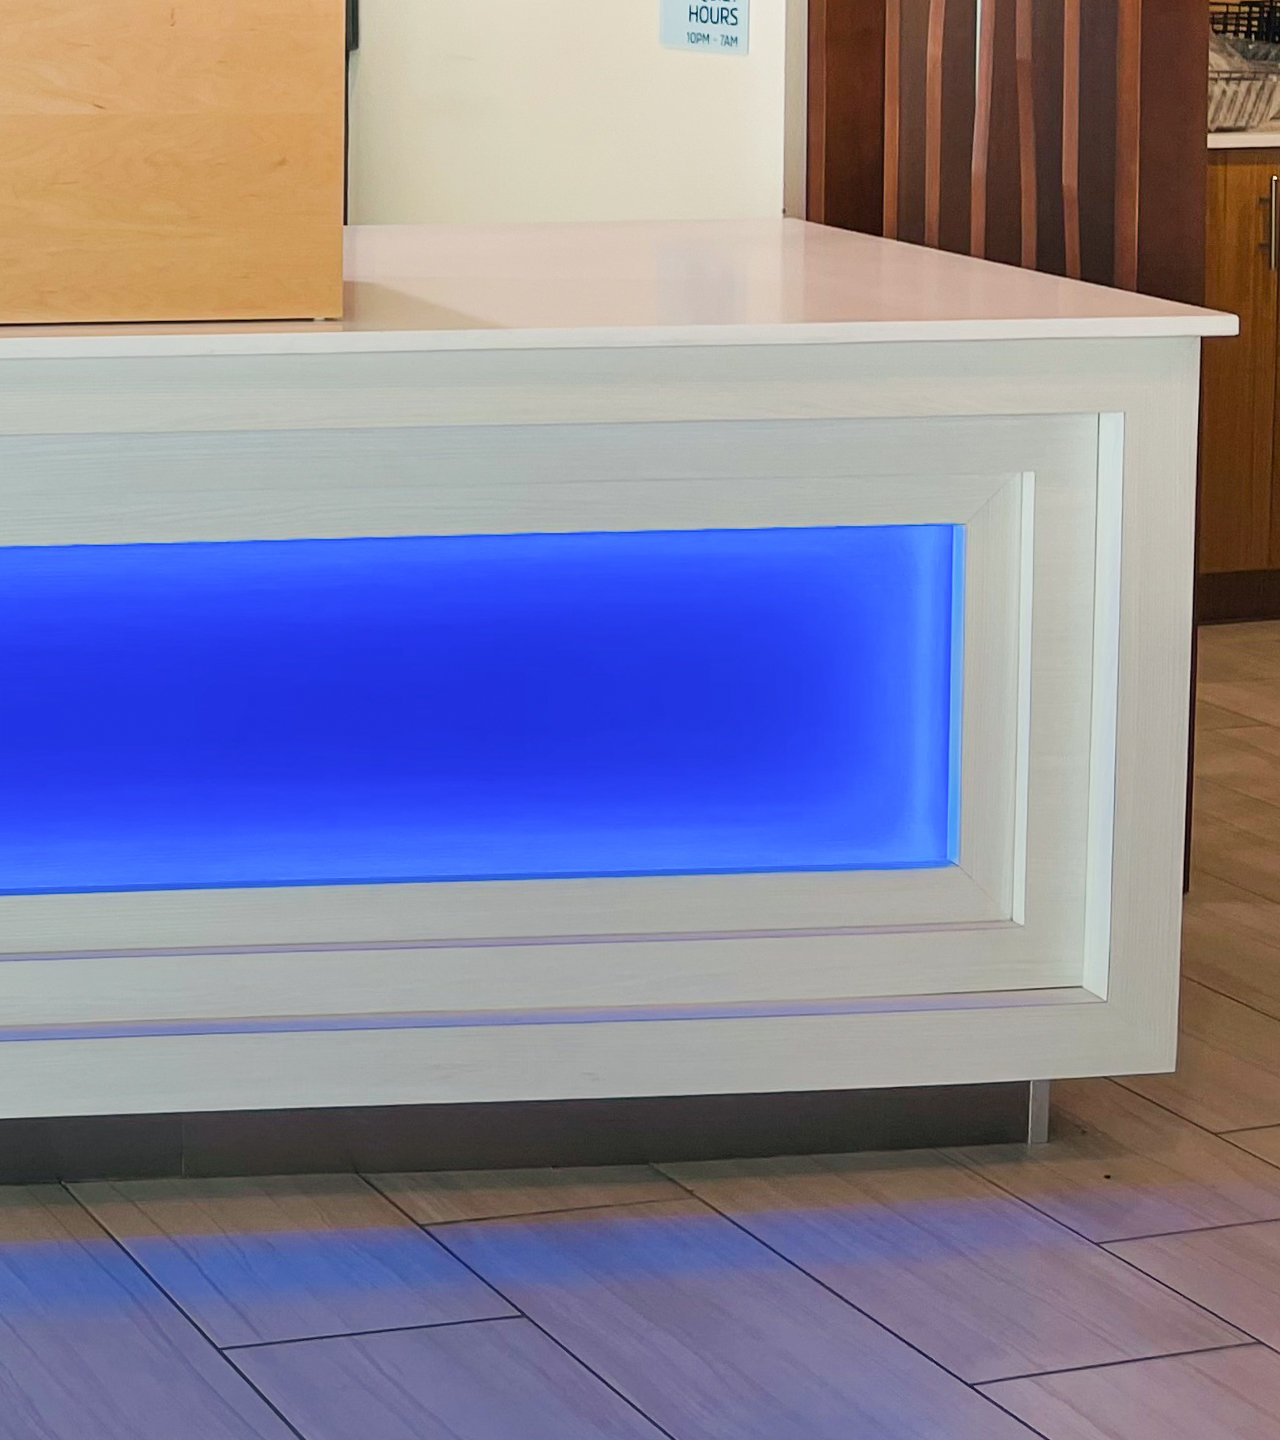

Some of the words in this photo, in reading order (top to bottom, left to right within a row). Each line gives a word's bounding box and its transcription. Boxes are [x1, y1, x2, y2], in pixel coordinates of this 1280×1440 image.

[688, 4, 738, 26] HOURS
[686, 32, 710, 45] 10PM
[720, 34, 738, 47] 7AM
